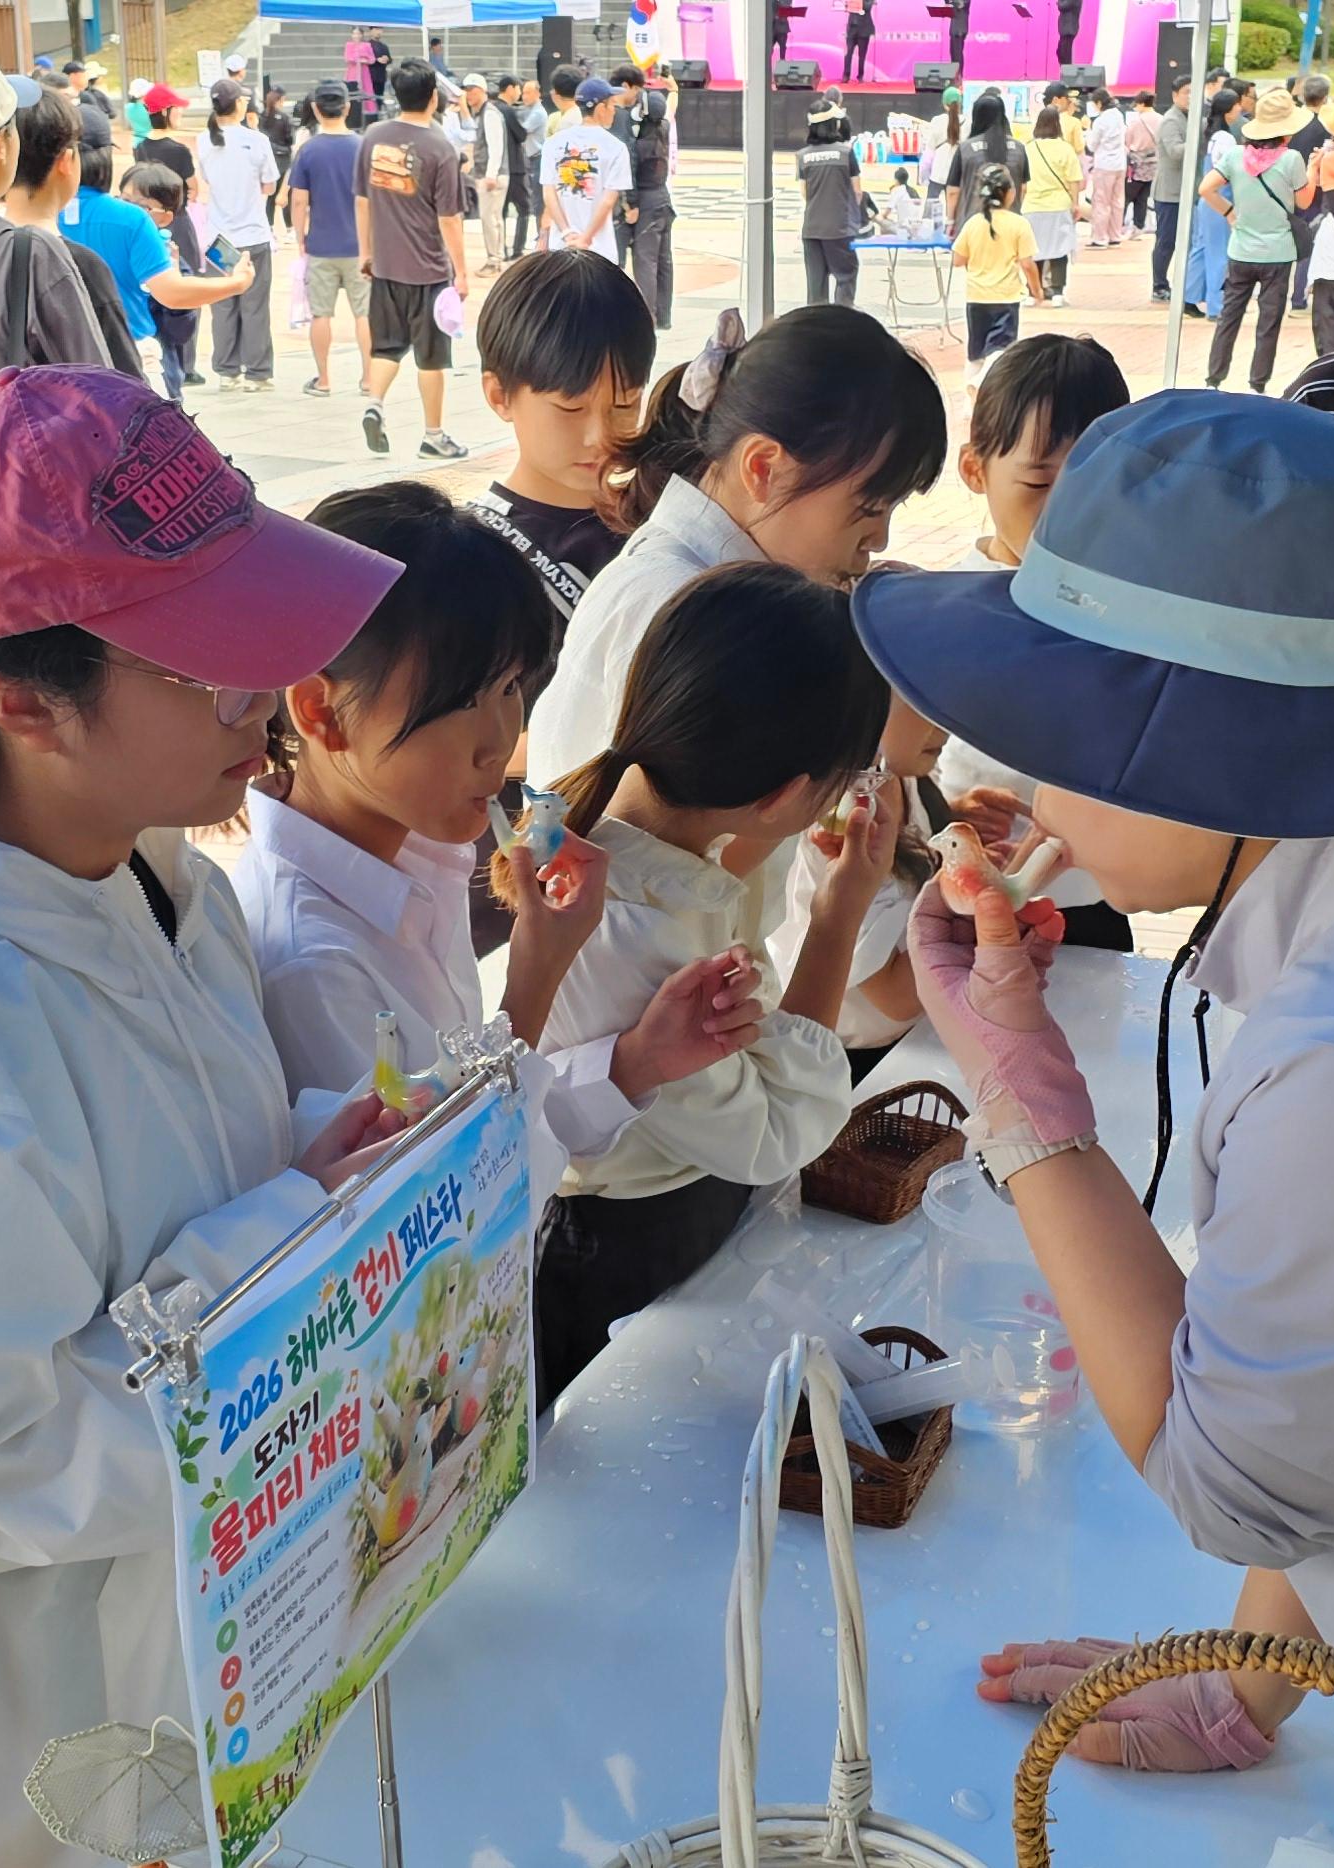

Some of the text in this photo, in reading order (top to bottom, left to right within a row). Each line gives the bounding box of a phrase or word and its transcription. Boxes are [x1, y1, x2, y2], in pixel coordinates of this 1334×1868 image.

[219, 1173, 463, 1455] 2026 해마루 걷기 페스타
[210, 1396, 361, 1577] 물피리 체험
[253, 1390, 319, 1480] 도자기
